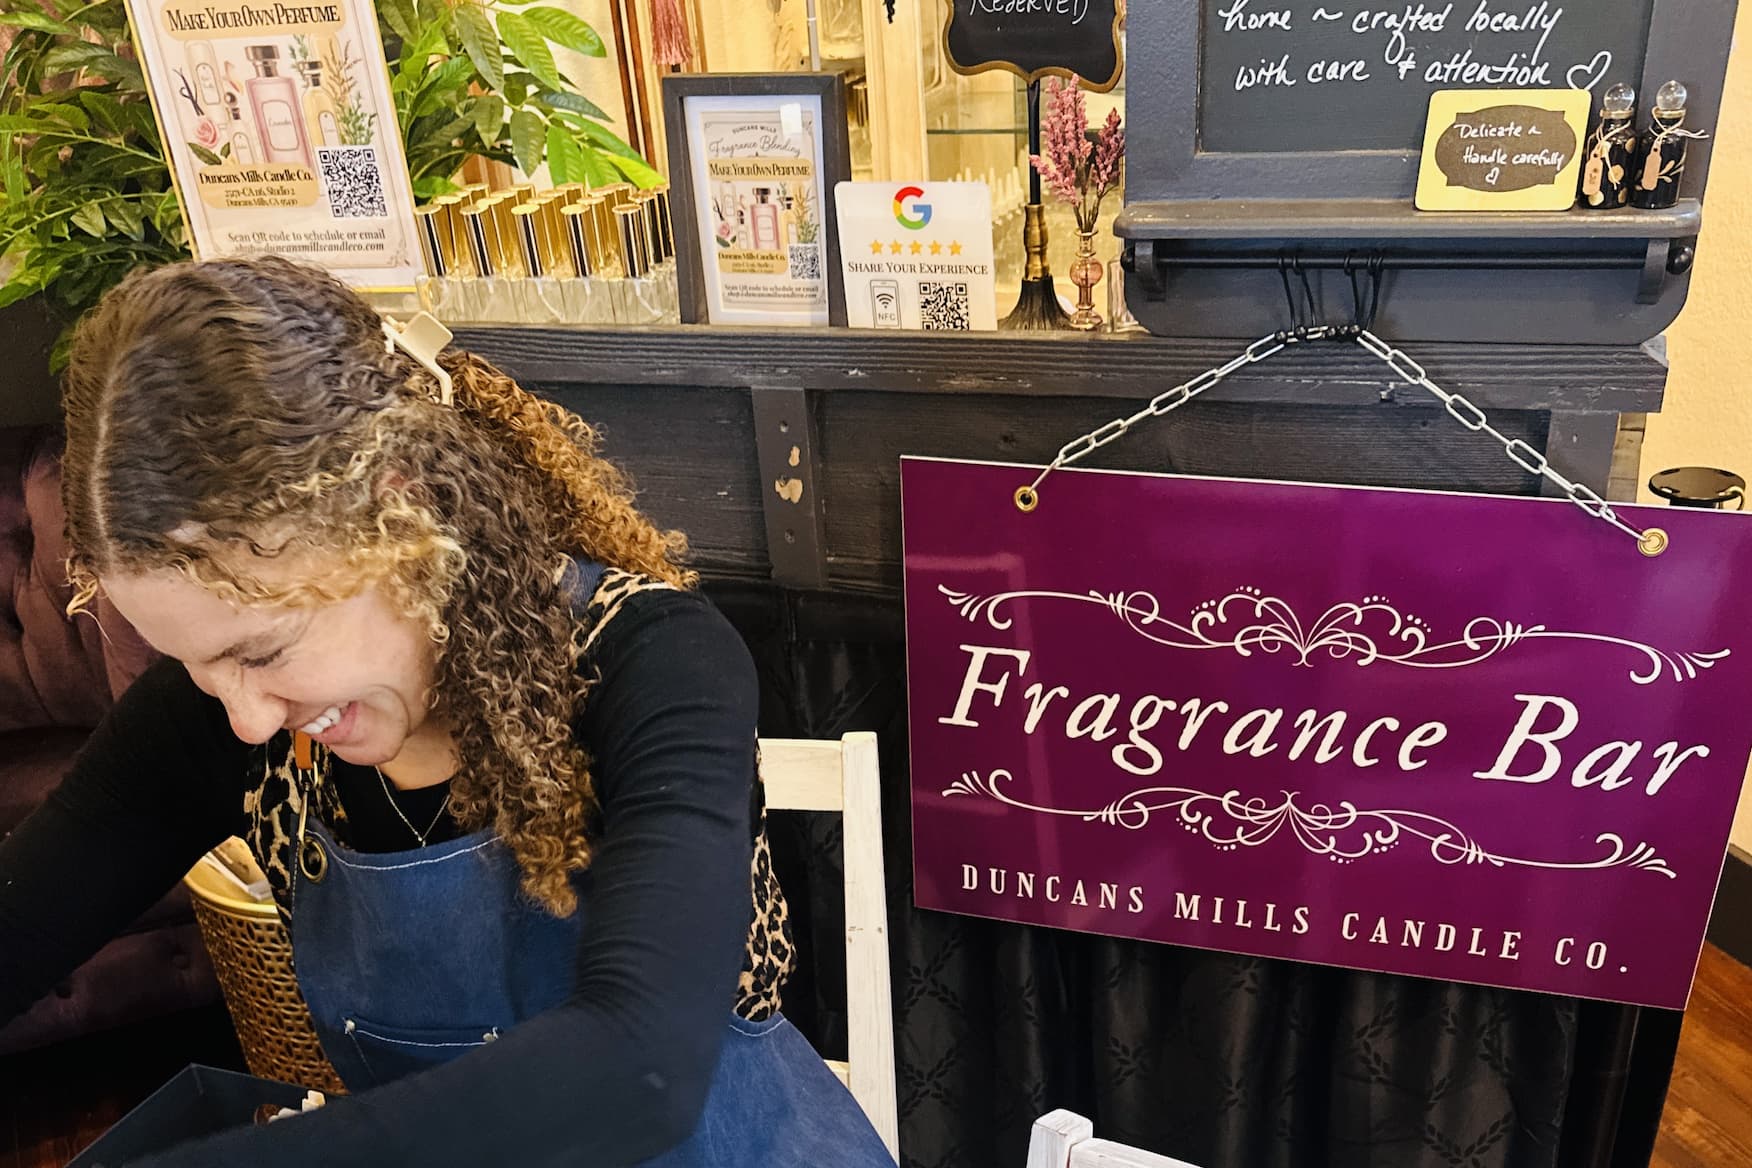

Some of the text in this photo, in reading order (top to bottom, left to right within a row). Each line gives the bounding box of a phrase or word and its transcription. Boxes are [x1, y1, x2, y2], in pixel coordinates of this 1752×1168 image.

[167, 3, 341, 32] MAKE YOUR OWN PERFUME
[1218, 0, 1291, 31] home
[1352, 3, 1453, 64] crafted
[1465, 0, 1564, 65] locally
[1235, 54, 1296, 90] with
[1307, 60, 1370, 83] care
[1424, 50, 1551, 86] attention
[1453, 121, 1523, 139] Delicate
[709, 135, 801, 158] Fragrance Blending
[1463, 145, 1565, 171] Handle carefully
[199, 169, 313, 184] Duncans Mills Candle Co.
[710, 163, 810, 176] MAKE YOUR OWN PERFUME
[228, 229, 386, 243] Scan QR code to schedule or email
[848, 261, 989, 275] SHARE YOUR EXPERIENCE
[878, 313, 896, 321] NFC
[938, 643, 1710, 796] Fragrance Bar
[962, 864, 1629, 974] DUNCANS MILLS CANDLE CO.
